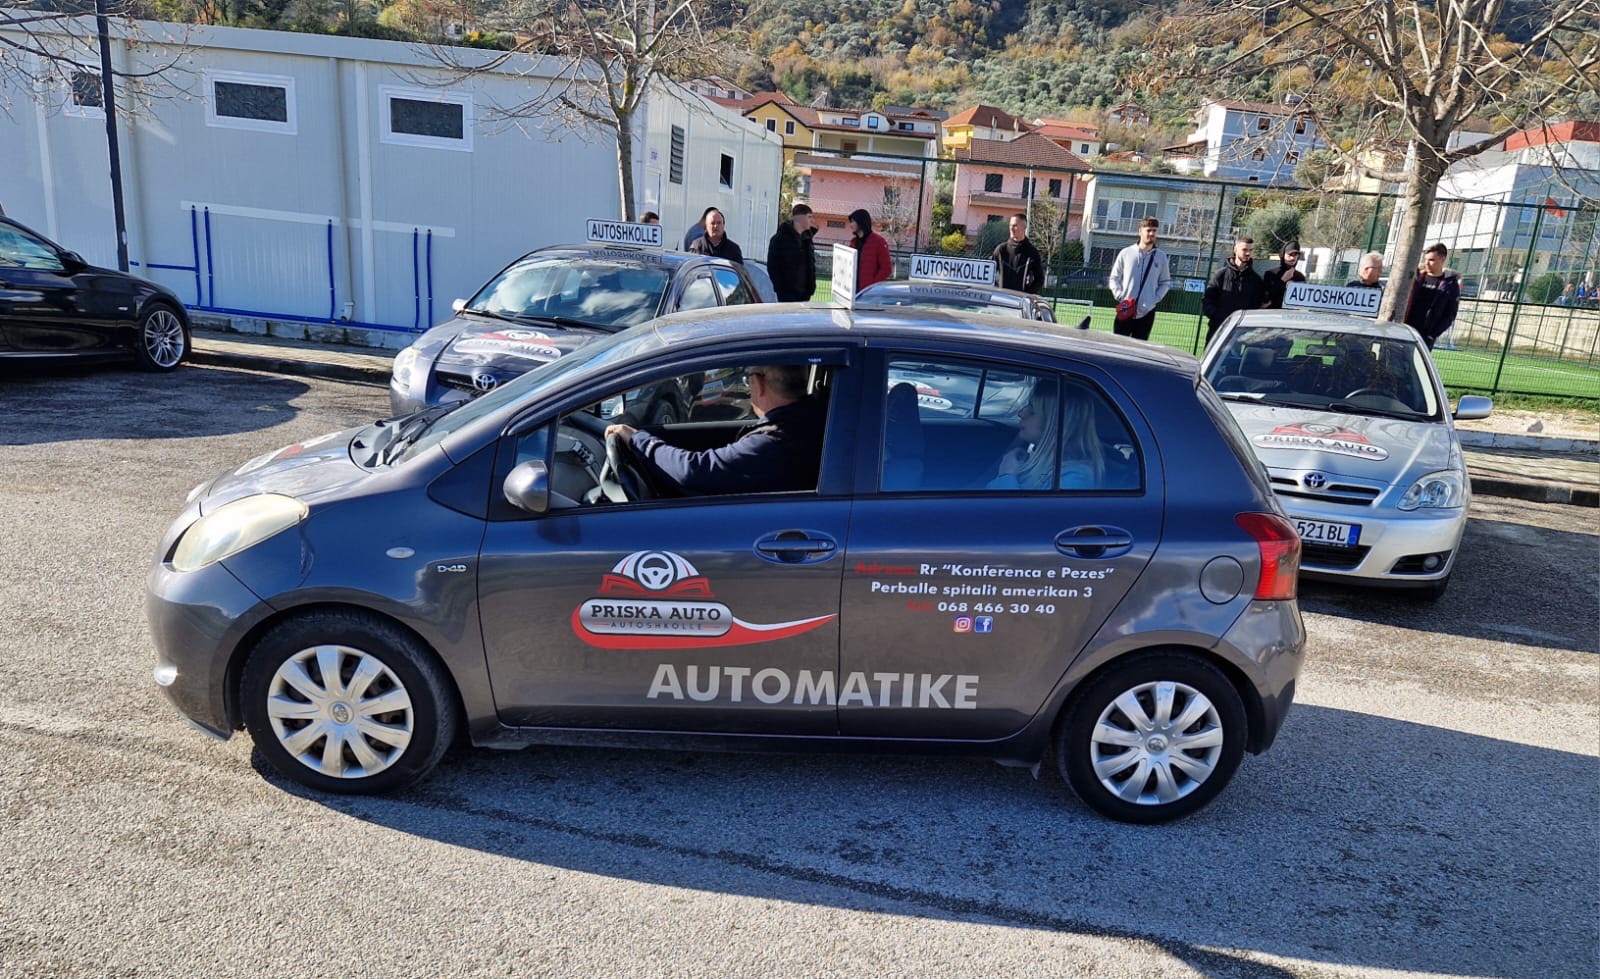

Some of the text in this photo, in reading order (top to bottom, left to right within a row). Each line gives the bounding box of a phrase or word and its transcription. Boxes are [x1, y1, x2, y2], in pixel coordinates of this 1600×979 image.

[591, 223, 658, 243] AUTOSHKOLLE
[914, 258, 990, 281] AUTOSHKOLLE
[1289, 287, 1377, 308] AUTOSHKOLLE
[1333, 442, 1378, 453] AUTO
[920, 563, 938, 576] Rr
[1047, 569, 1056, 578] e
[871, 581, 1093, 598] Perballe spitalit amerikan 3
[591, 604, 721, 621] PRISKA AUTO
[937, 601, 968, 613] 068
[973, 602, 1004, 614] 466
[1009, 603, 1030, 614] 30
[1035, 604, 1056, 615] 40
[610, 621, 702, 631] AUTOSHKOLLE
[646, 663, 980, 710] AUTOMATIKE
